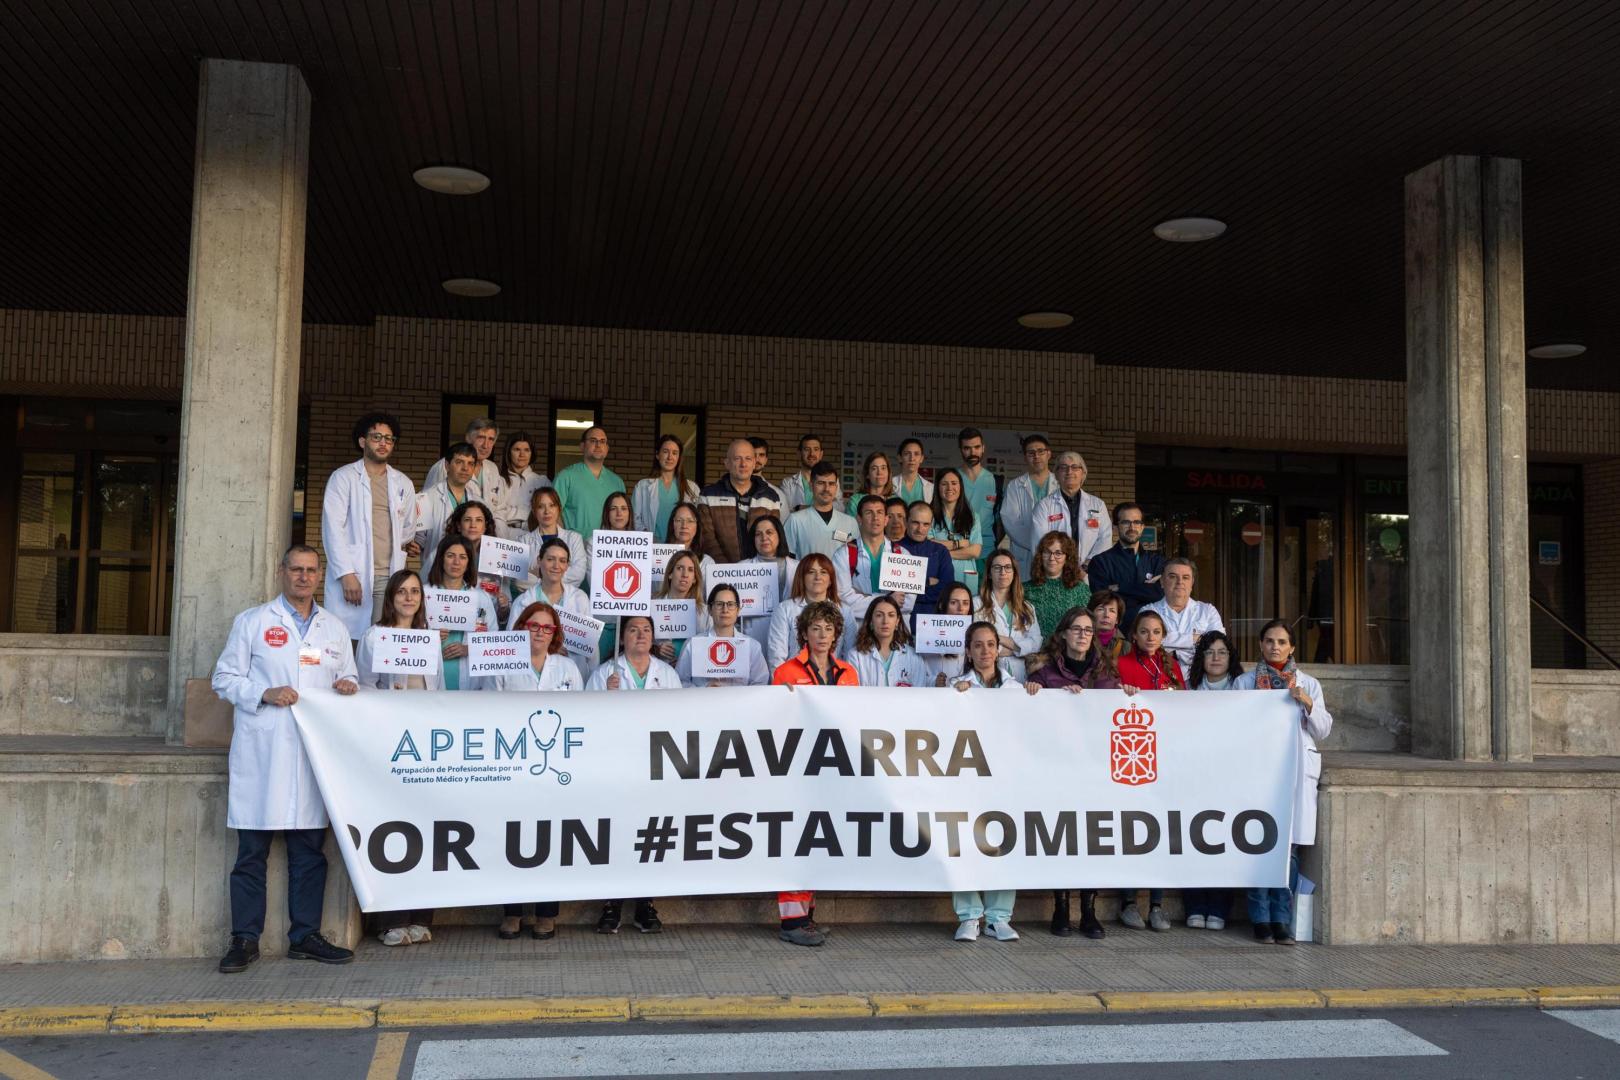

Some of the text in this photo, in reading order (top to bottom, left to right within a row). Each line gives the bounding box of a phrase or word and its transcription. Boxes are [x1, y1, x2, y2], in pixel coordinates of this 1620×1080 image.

[912, 431, 941, 440] Hospital
[1186, 472, 1267, 489] SALIDA
[1365, 480, 1406, 495] ENT
[597, 536, 648, 546] HORARIOS
[494, 541, 524, 554] TIEMPO
[596, 548, 648, 560] SIN LÍMITE
[888, 556, 922, 567] NEGOCIAR
[496, 562, 521, 573] SALUD
[651, 567, 664, 575] SAL
[891, 568, 902, 577] NO
[712, 568, 772, 578] CONCILIACIÓN
[882, 580, 922, 591] CONVERSAR
[436, 594, 470, 604] TIEMPO
[592, 601, 648, 611] ESCLAVITUD
[656, 604, 688, 612] TIEMPO
[438, 615, 467, 624] SALUD
[930, 619, 964, 628] TIEMPO
[660, 624, 687, 632] SALUD
[392, 634, 430, 644] TIEMPO
[472, 634, 526, 644] RETRIBUCIÓN
[934, 640, 962, 648] SALUD
[562, 638, 594, 654] MACIÓN
[482, 648, 516, 657] ACORDE
[394, 658, 427, 667] SALUD
[472, 662, 529, 672] A FORMACIÓN
[649, 728, 992, 780] NAVARRA
[391, 766, 435, 774] Agrupación
[447, 765, 497, 773] Profesionales
[498, 766, 512, 774] por
[402, 776, 434, 784] Estatuto
[436, 775, 463, 783] Médico
[470, 774, 511, 782] Facultativo
[505, 818, 611, 868] UN
[634, 809, 1279, 863] #ESTATUTOMEDICO
